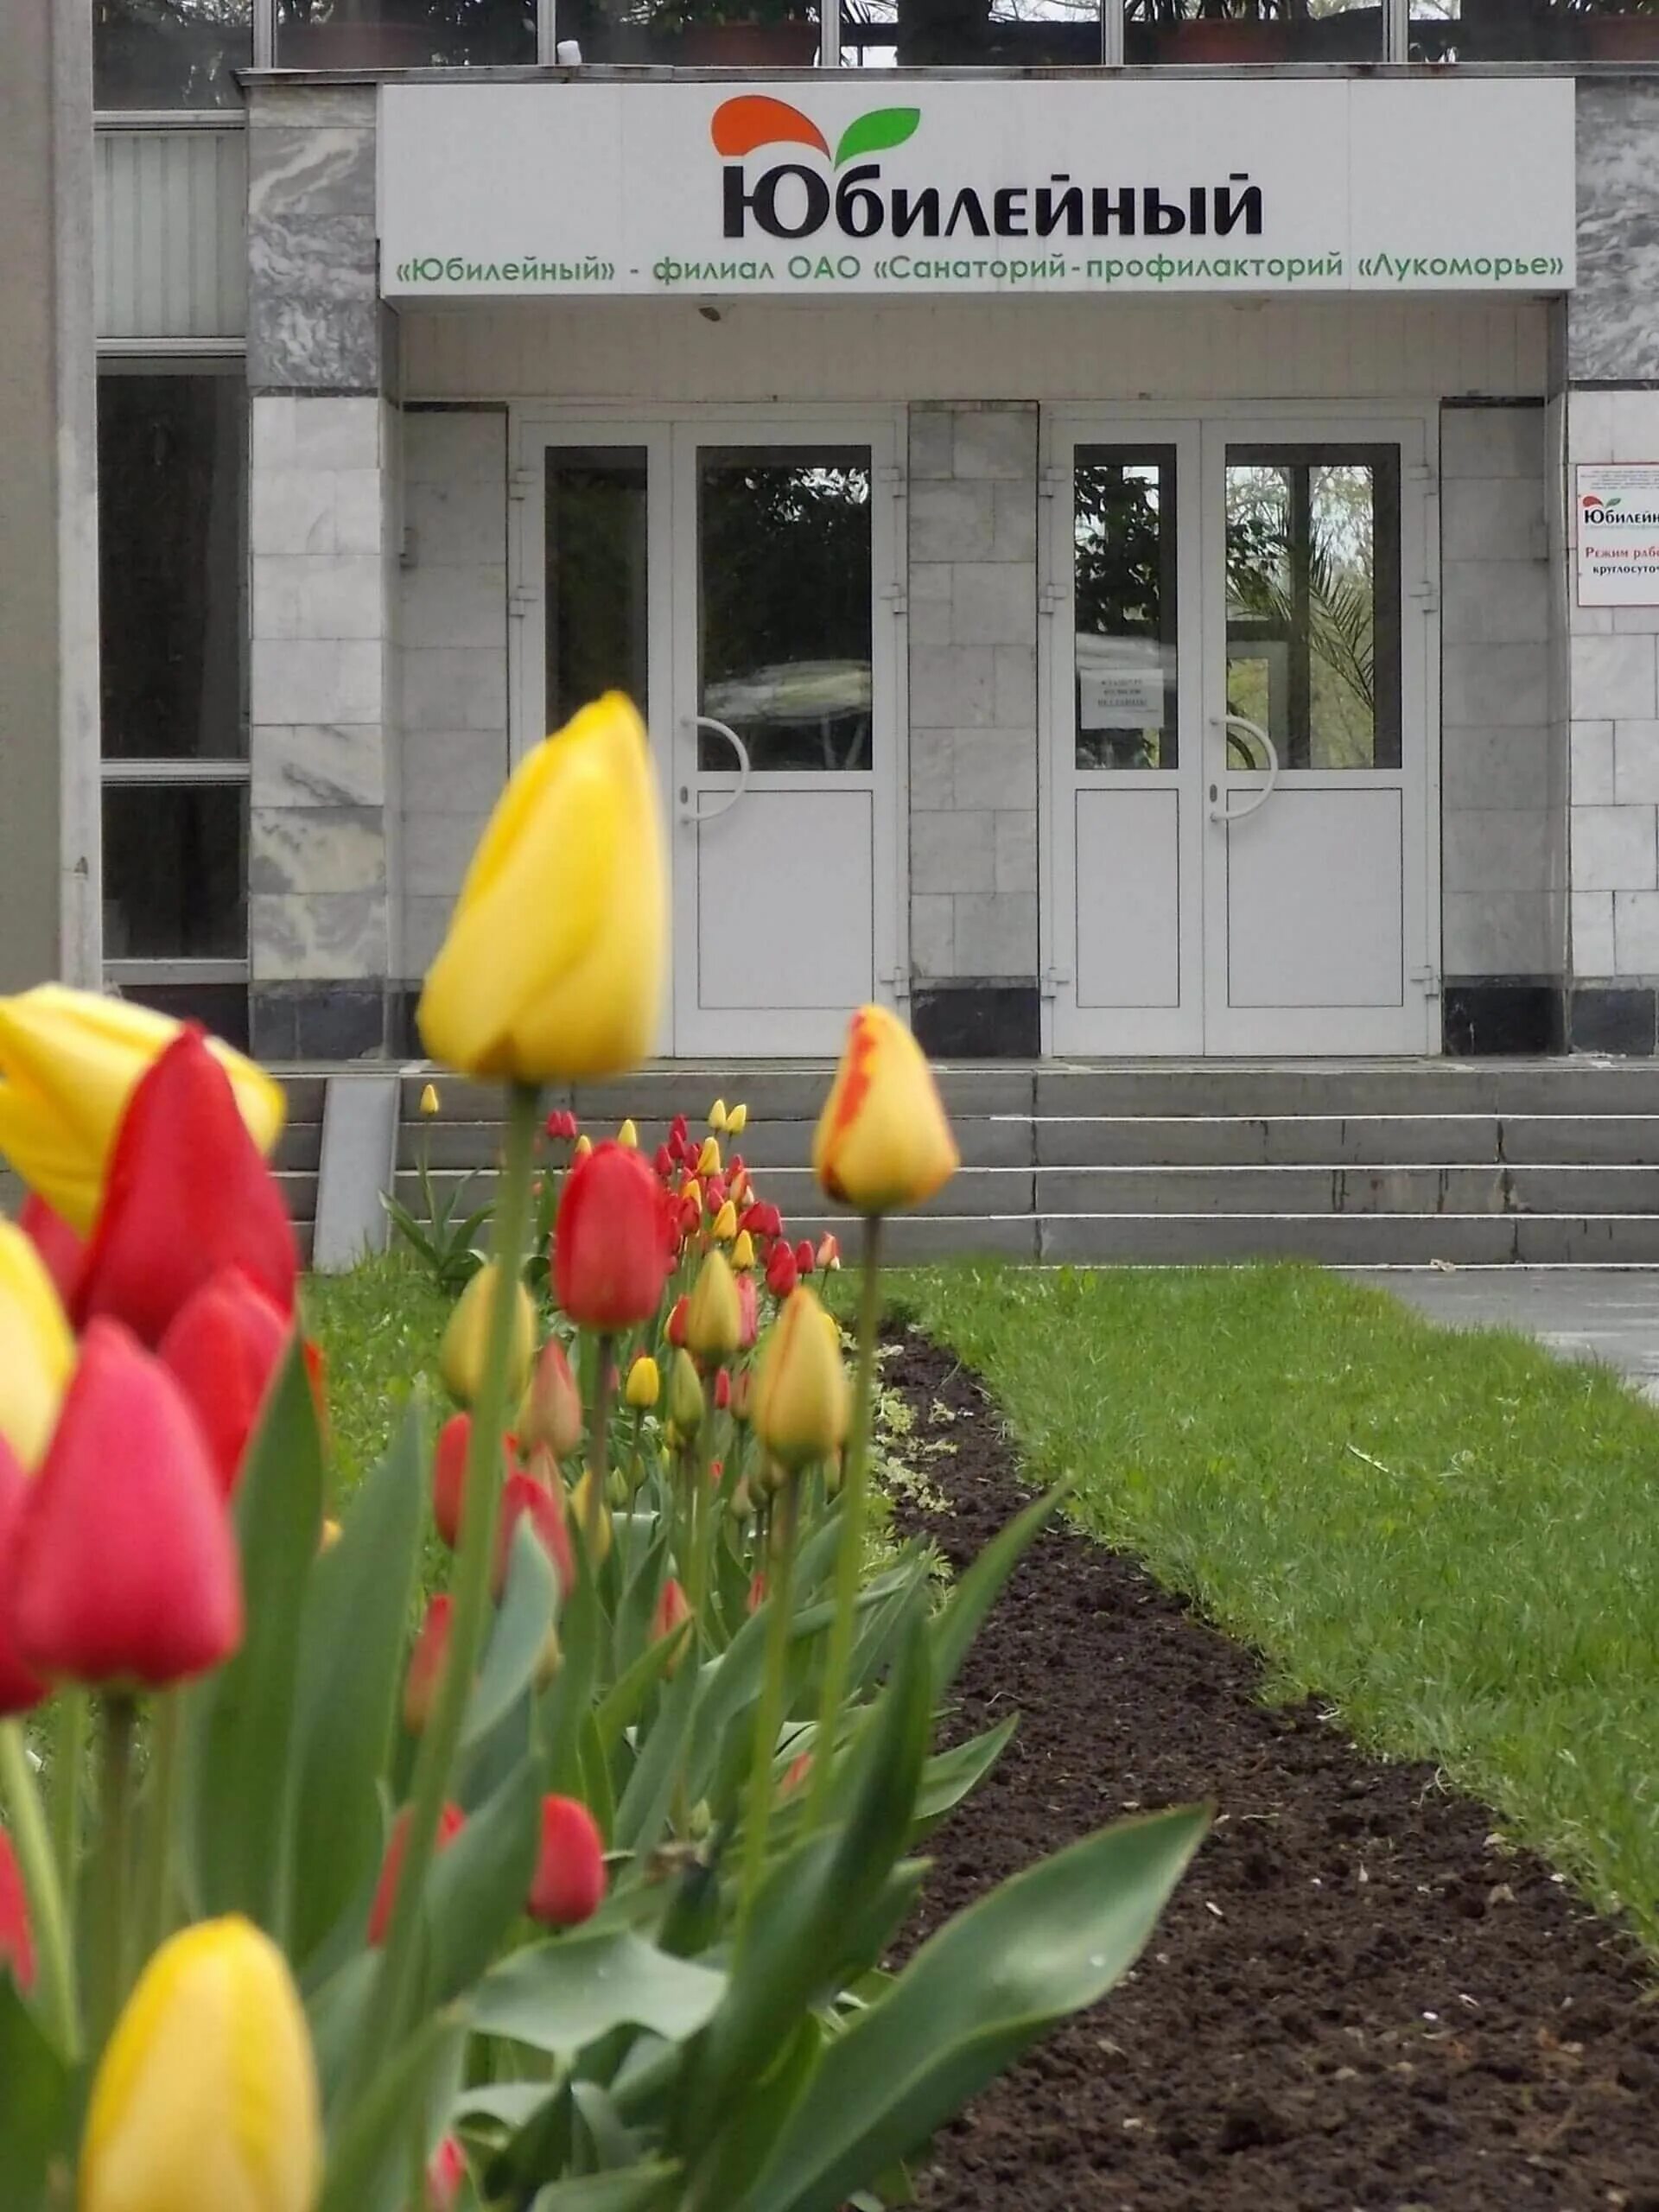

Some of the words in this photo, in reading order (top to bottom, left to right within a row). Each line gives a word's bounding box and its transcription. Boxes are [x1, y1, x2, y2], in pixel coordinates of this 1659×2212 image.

[722, 163, 1262, 238] Юбилейный
[396, 257, 615, 282] «Юбилейный»
[653, 256, 775, 285] филиал
[787, 256, 861, 280] ОАО
[1357, 252, 1565, 279] «Лукоморье»
[1585, 546, 1629, 558] Режим
